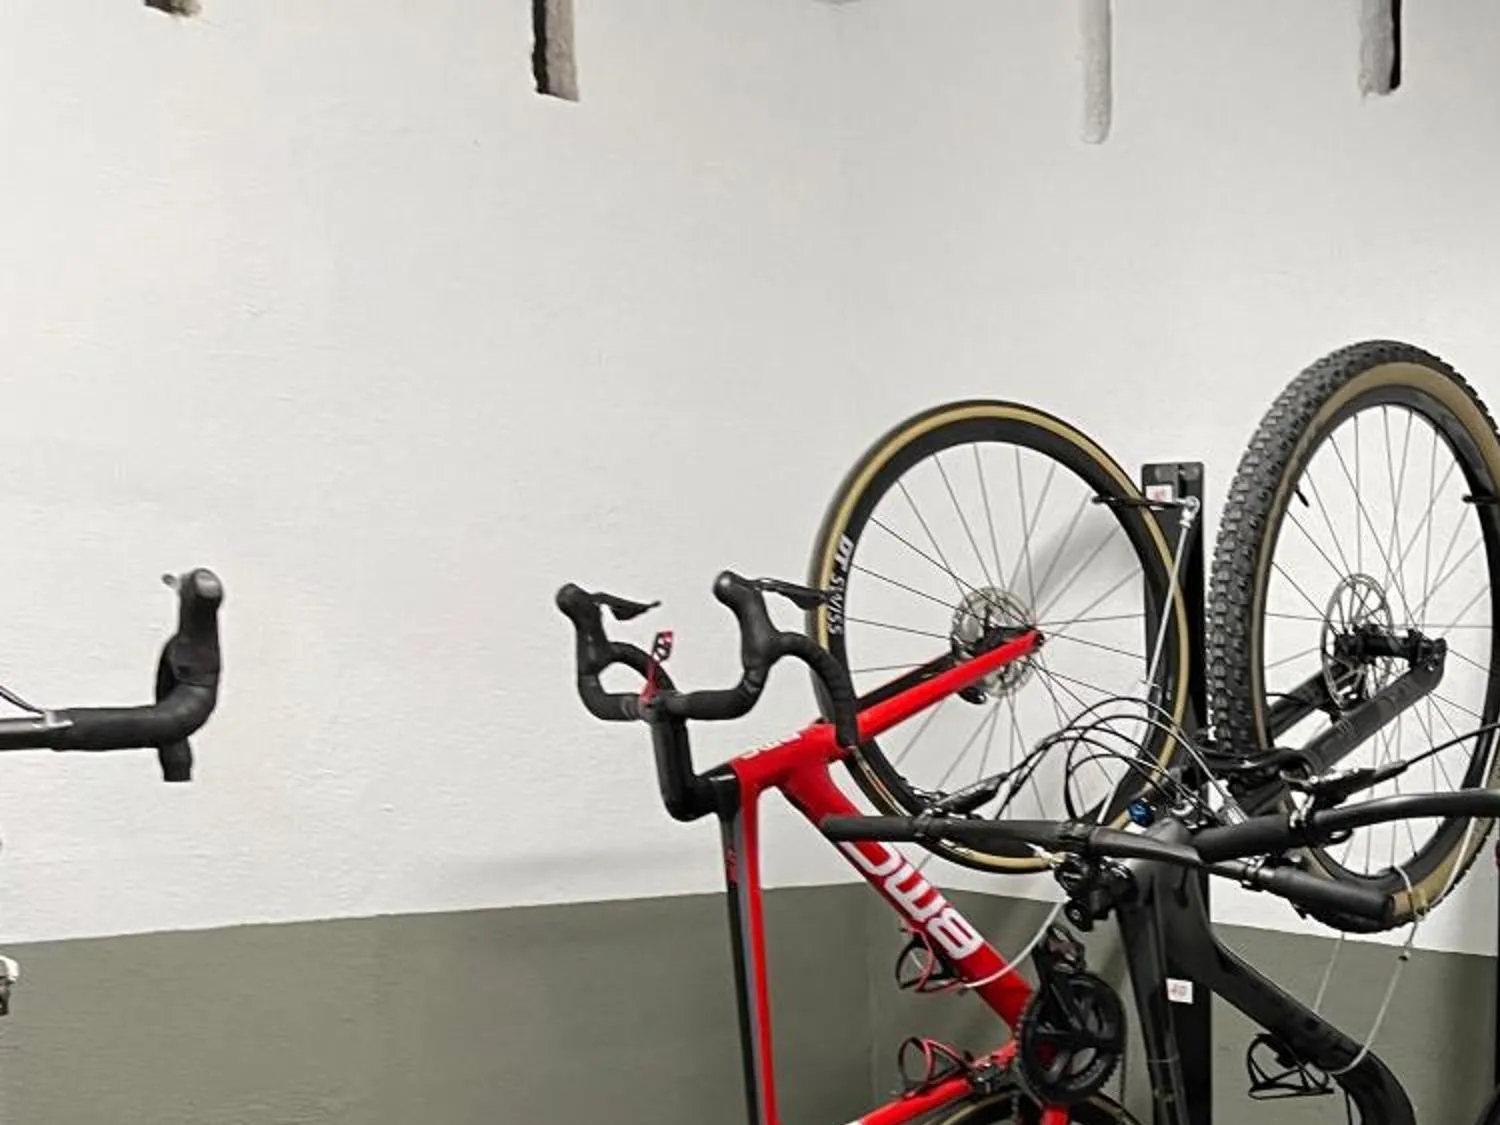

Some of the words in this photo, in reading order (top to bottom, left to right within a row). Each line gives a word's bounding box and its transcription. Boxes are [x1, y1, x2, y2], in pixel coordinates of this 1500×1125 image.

[834, 534, 854, 573] DT
[827, 574, 846, 636] SWISS
[838, 842, 984, 960] BMC
